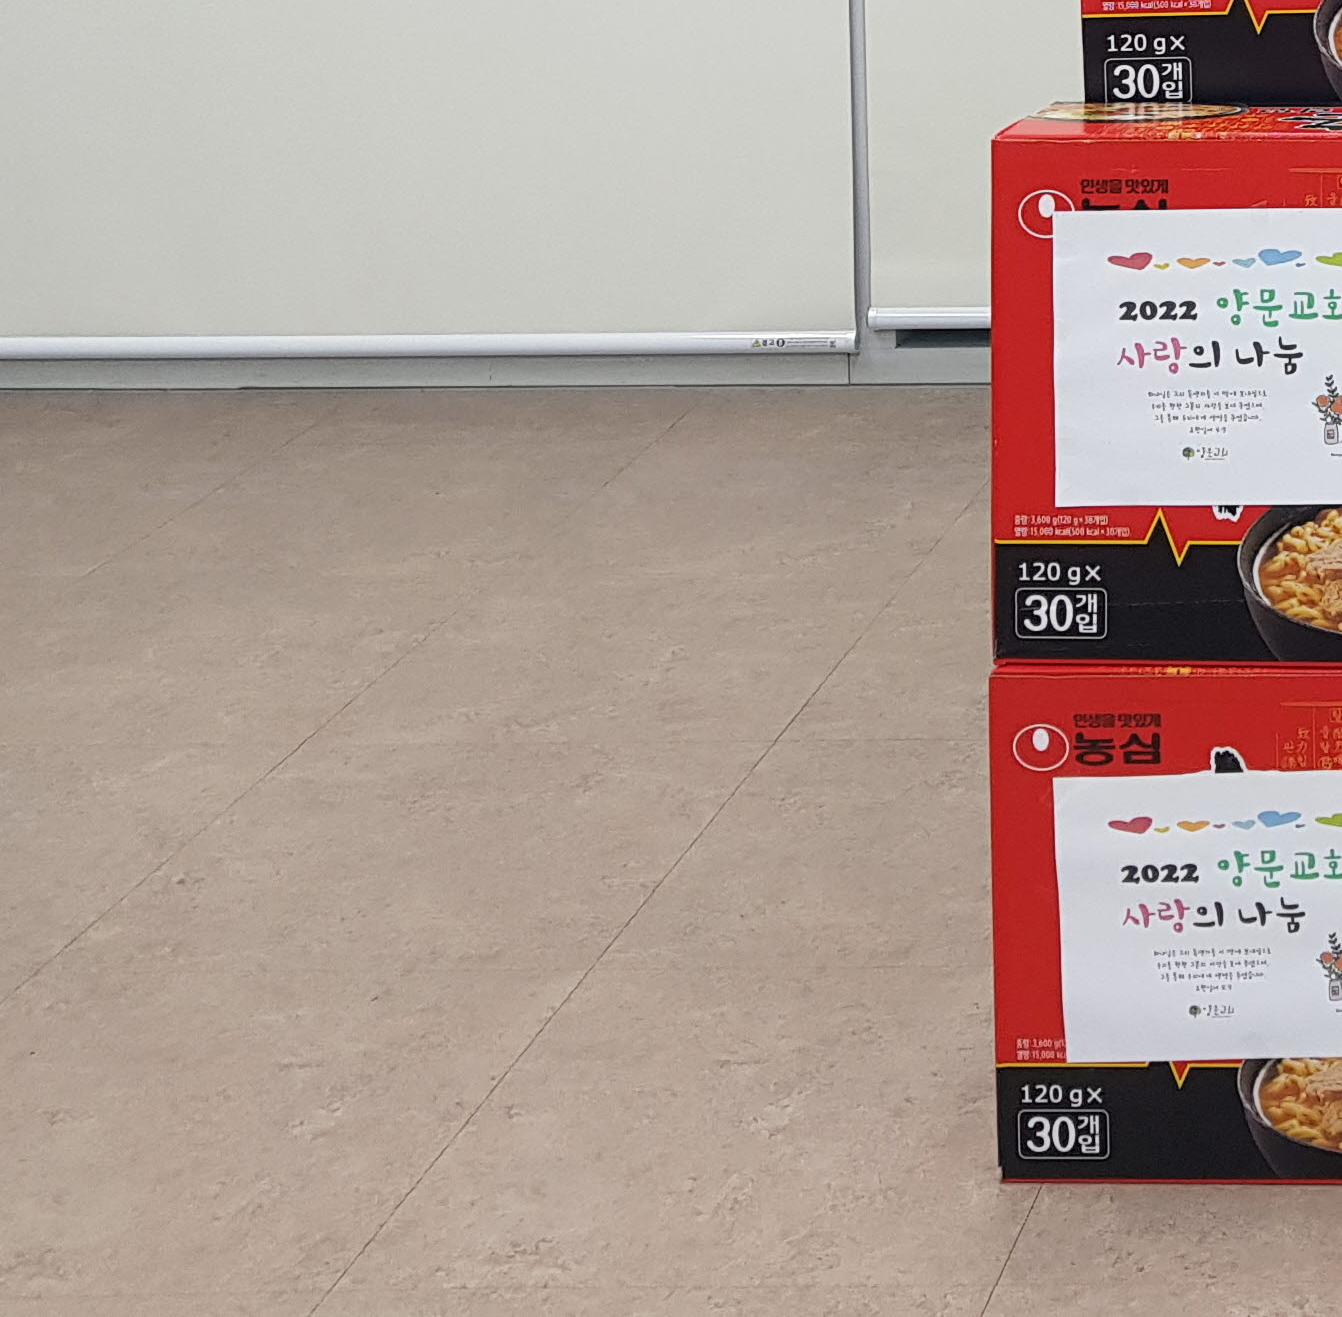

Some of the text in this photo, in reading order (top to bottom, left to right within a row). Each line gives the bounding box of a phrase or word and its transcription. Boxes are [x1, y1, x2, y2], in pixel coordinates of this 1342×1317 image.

[1106, 34, 1147, 53] 120
[1118, 300, 1198, 322] 2022
[1116, 335, 1304, 376] 사랑의 나눔
[1018, 561, 1061, 582] 120
[1072, 732, 1161, 765] 농심
[1120, 863, 1200, 885] 2022
[1122, 896, 1306, 934] 사랑의 나눔
[1021, 1085, 1063, 1104] 120
